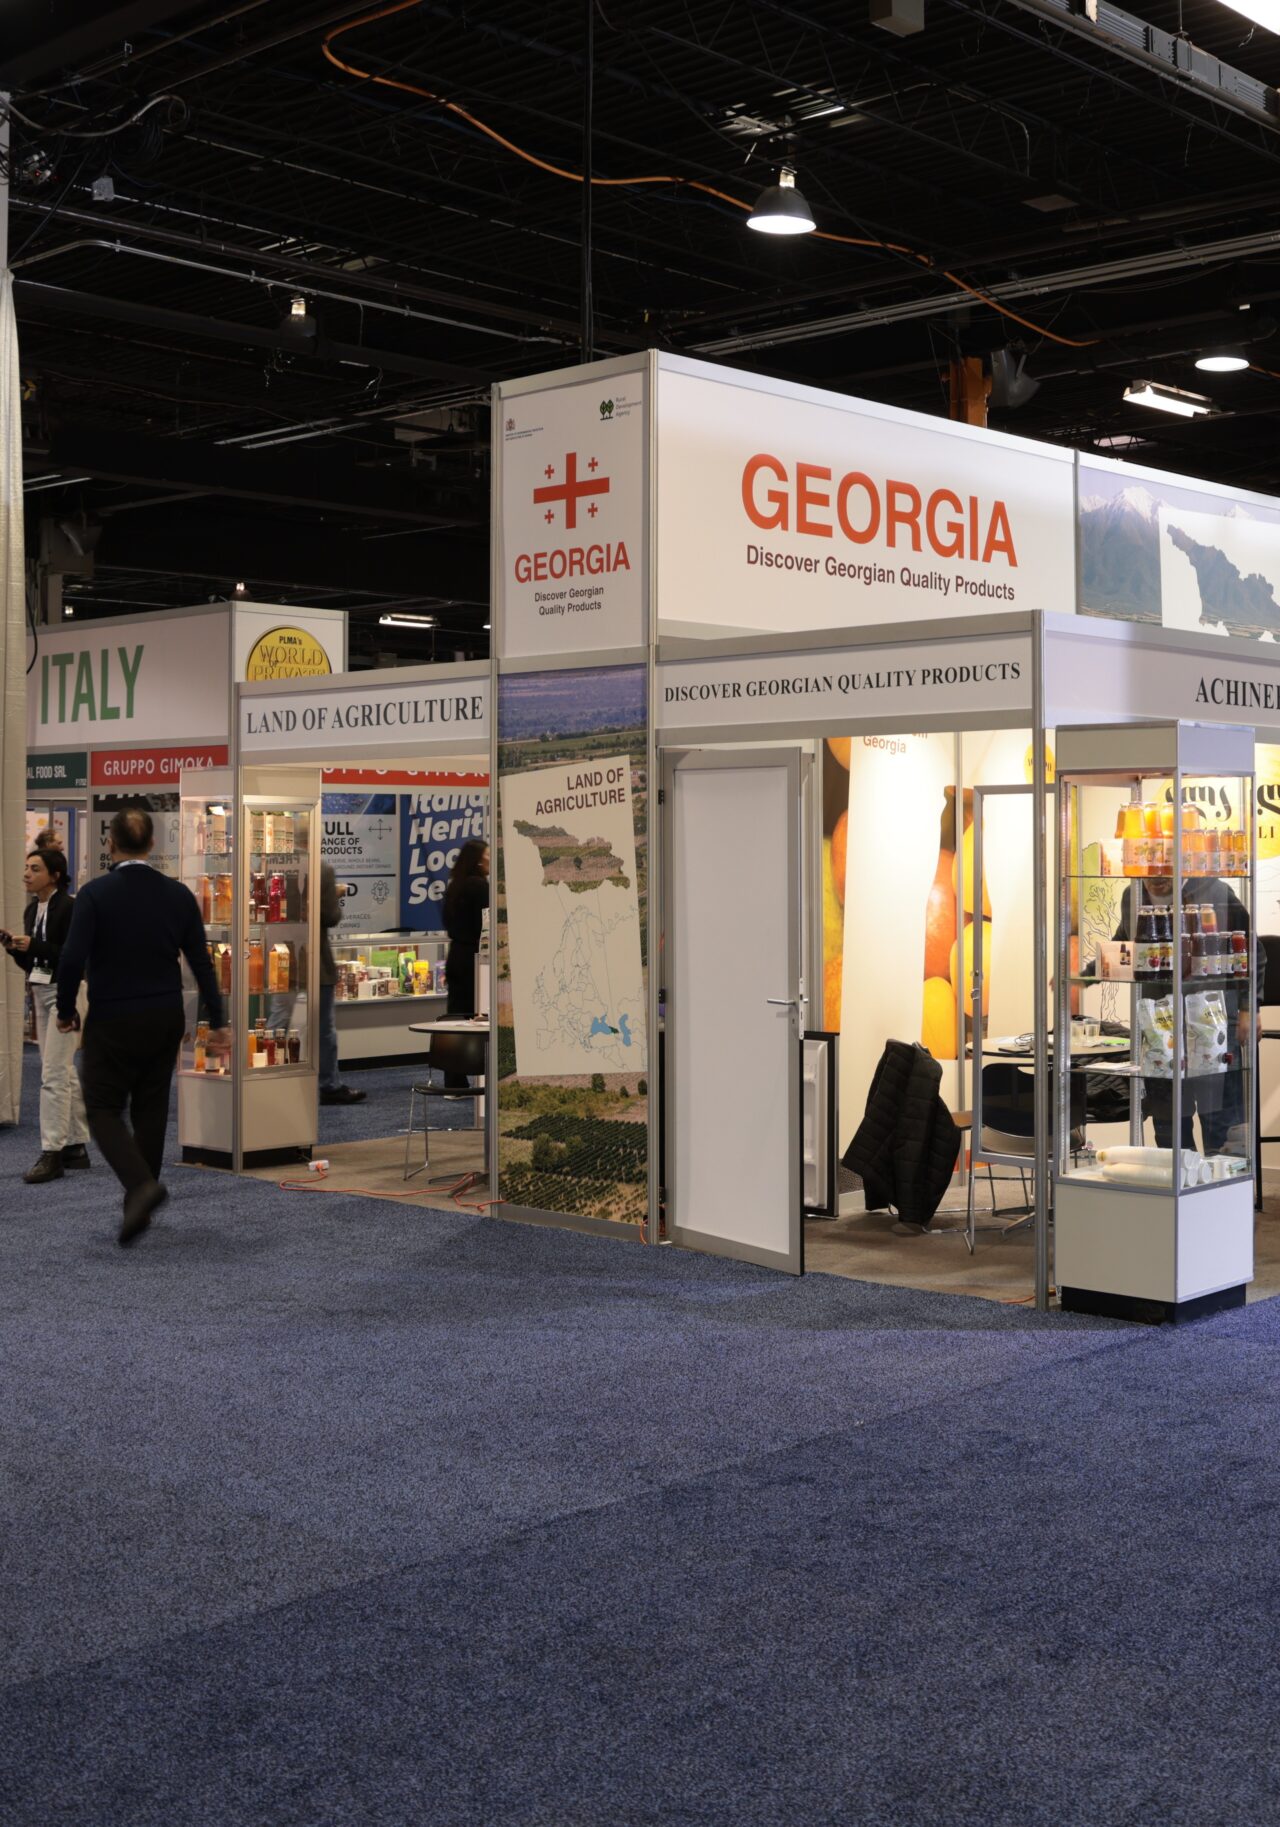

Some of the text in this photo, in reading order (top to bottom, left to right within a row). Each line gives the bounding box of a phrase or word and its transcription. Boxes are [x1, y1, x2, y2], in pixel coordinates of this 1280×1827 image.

[741, 453, 1018, 568] GEORGIA
[514, 541, 631, 583] GEORGIA
[746, 545, 1015, 600] Discover Georgian Quality Products
[534, 585, 604, 602] Discover Georgian
[538, 600, 602, 616] Quality Products
[278, 635, 303, 645] PLMA's
[259, 645, 324, 667] WORLD
[41, 644, 144, 725] ITALY
[664, 661, 1021, 703] DISCOVER GEORGIAN QUALITY PRODUCTS
[246, 696, 484, 734] LAND OF AGRICULTURE
[862, 737, 907, 755] Georgia
[35, 766, 53, 779] FOOD
[103, 756, 214, 776] GRUPPO GIMOKA
[567, 768, 624, 790] LAND OF
[535, 788, 626, 816] AGRICULTURE
[324, 821, 354, 836] ULL
[408, 809, 486, 846] Herit
[320, 846, 363, 855] RODUCTS
[321, 837, 360, 846] ANGE OF
